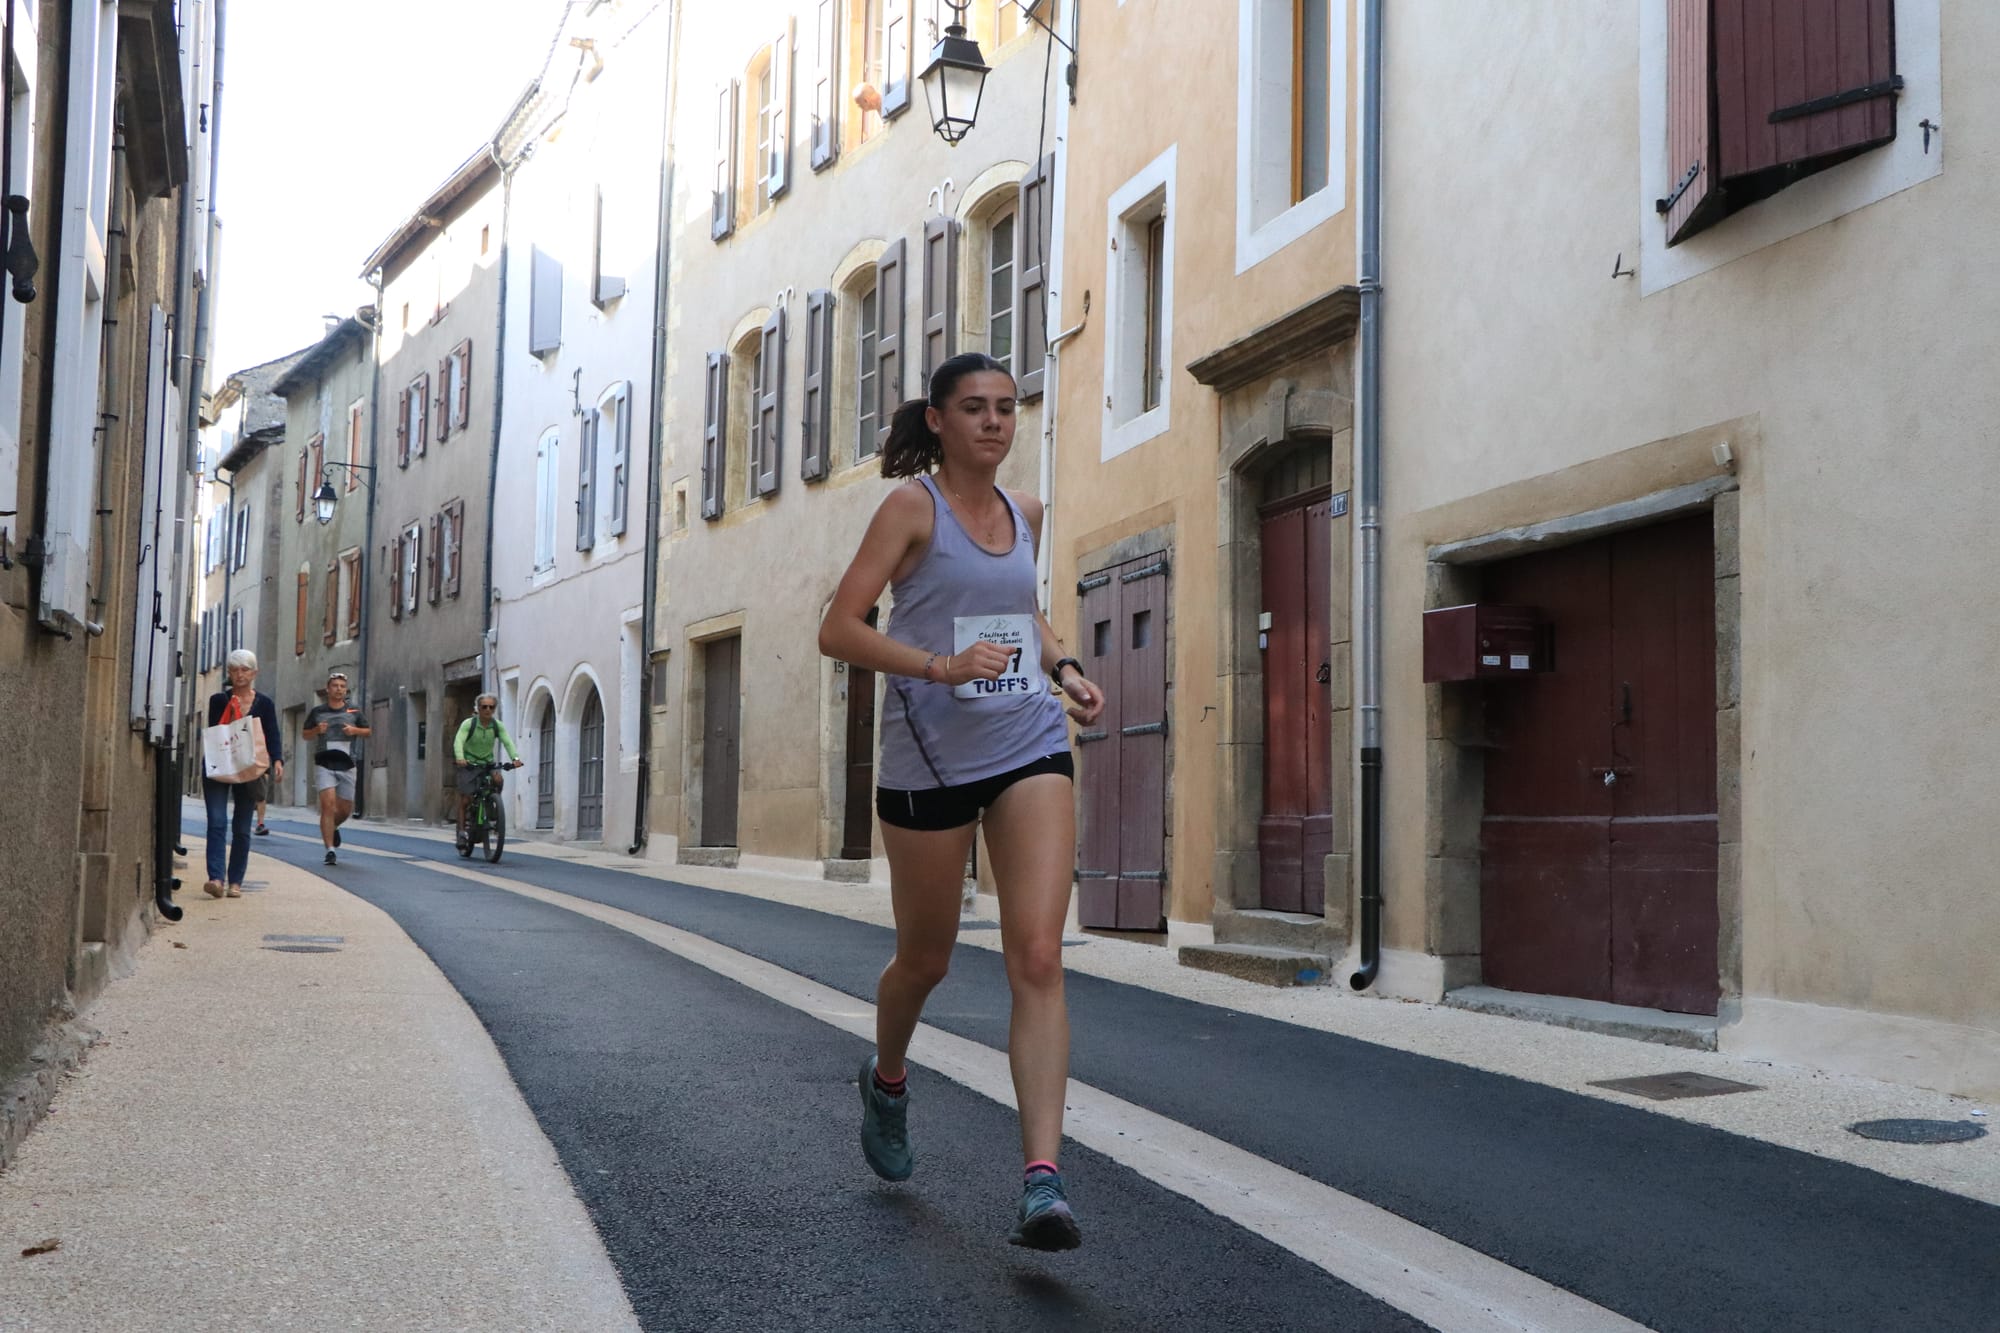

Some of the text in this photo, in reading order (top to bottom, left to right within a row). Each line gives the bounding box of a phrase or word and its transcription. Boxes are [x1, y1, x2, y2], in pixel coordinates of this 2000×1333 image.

[1334, 496, 1345, 512] 17
[978, 632, 1009, 640] Challenge
[834, 661, 845, 673] 15
[973, 677, 1029, 694] TUFF'S
